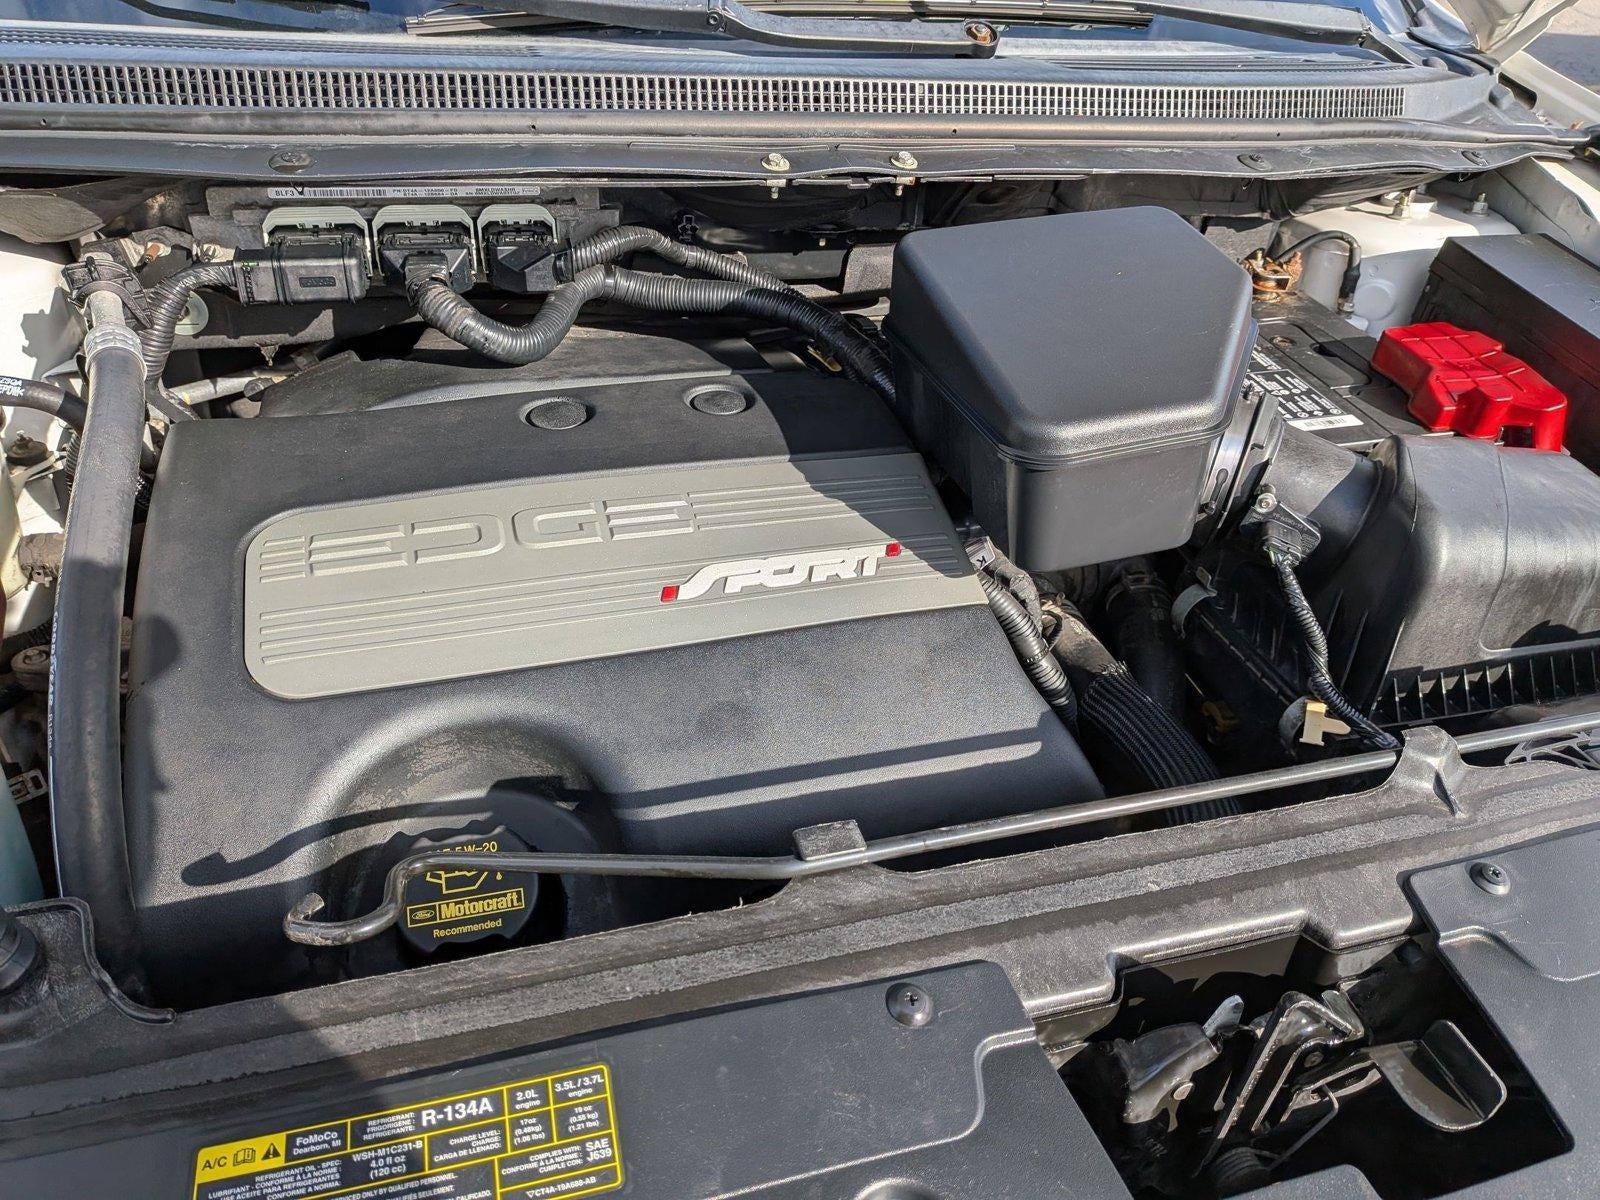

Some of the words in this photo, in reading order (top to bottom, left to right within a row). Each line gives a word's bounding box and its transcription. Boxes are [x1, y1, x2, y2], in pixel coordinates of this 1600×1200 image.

[308, 500, 694, 576] EDGE
[661, 541, 902, 601] SPORT
[440, 892, 519, 919] Motorcraft
[433, 918, 503, 938] Recommended
[554, 1080, 576, 1093] 3.5L
[582, 1074, 604, 1086] 3.7L
[516, 1089, 539, 1101] 2.0L
[568, 1087, 593, 1098] engine
[422, 1097, 494, 1127] R-134A
[514, 1099, 541, 1110] engine
[368, 1112, 416, 1126] REFRIGERANT:
[296, 1131, 338, 1147] FoMoCo
[449, 1134, 477, 1146] CHARGE
[478, 1129, 501, 1139] LEVEL:
[471, 1136, 502, 1147] CHARGE:
[585, 1138, 610, 1152] SAE
[293, 1143, 331, 1156] Dearborn,
[331, 1139, 342, 1148] MI
[352, 1141, 423, 1162] WSH-M1C231-B
[434, 1152, 458, 1162] CARGA
[458, 1149, 468, 1157] DE
[469, 1142, 502, 1155] LLENADO:
[530, 1148, 562, 1162] COMPLIES
[562, 1145, 582, 1155] WITH:
[586, 1148, 613, 1162] J639
[201, 1156, 228, 1171] A/C
[370, 1158, 384, 1168] 4.0
[394, 1155, 406, 1163] oz
[501, 1162, 538, 1175] CONFORME
[545, 1158, 555, 1167] LA
[555, 1154, 579, 1165] NORME
[539, 1162, 566, 1174] CUMPLE
[566, 1158, 584, 1169] CON:
[255, 1167, 304, 1182] REFRIGERANT
[321, 1159, 342, 1169] SPEC:
[370, 1167, 390, 1180] (120
[391, 1164, 407, 1175] cc)
[208, 1185, 251, 1200] LUBRIFIANT
[255, 1175, 296, 1189] CONFORME
[312, 1167, 338, 1178] NORME
[263, 1185, 282, 1195] PARA
[283, 1173, 340, 1190] REFRIGERANTES
[361, 1188, 379, 1198] ONLY
[388, 1180, 420, 1194] QUALIFIED
[266, 1187, 307, 1200] CONFORME
